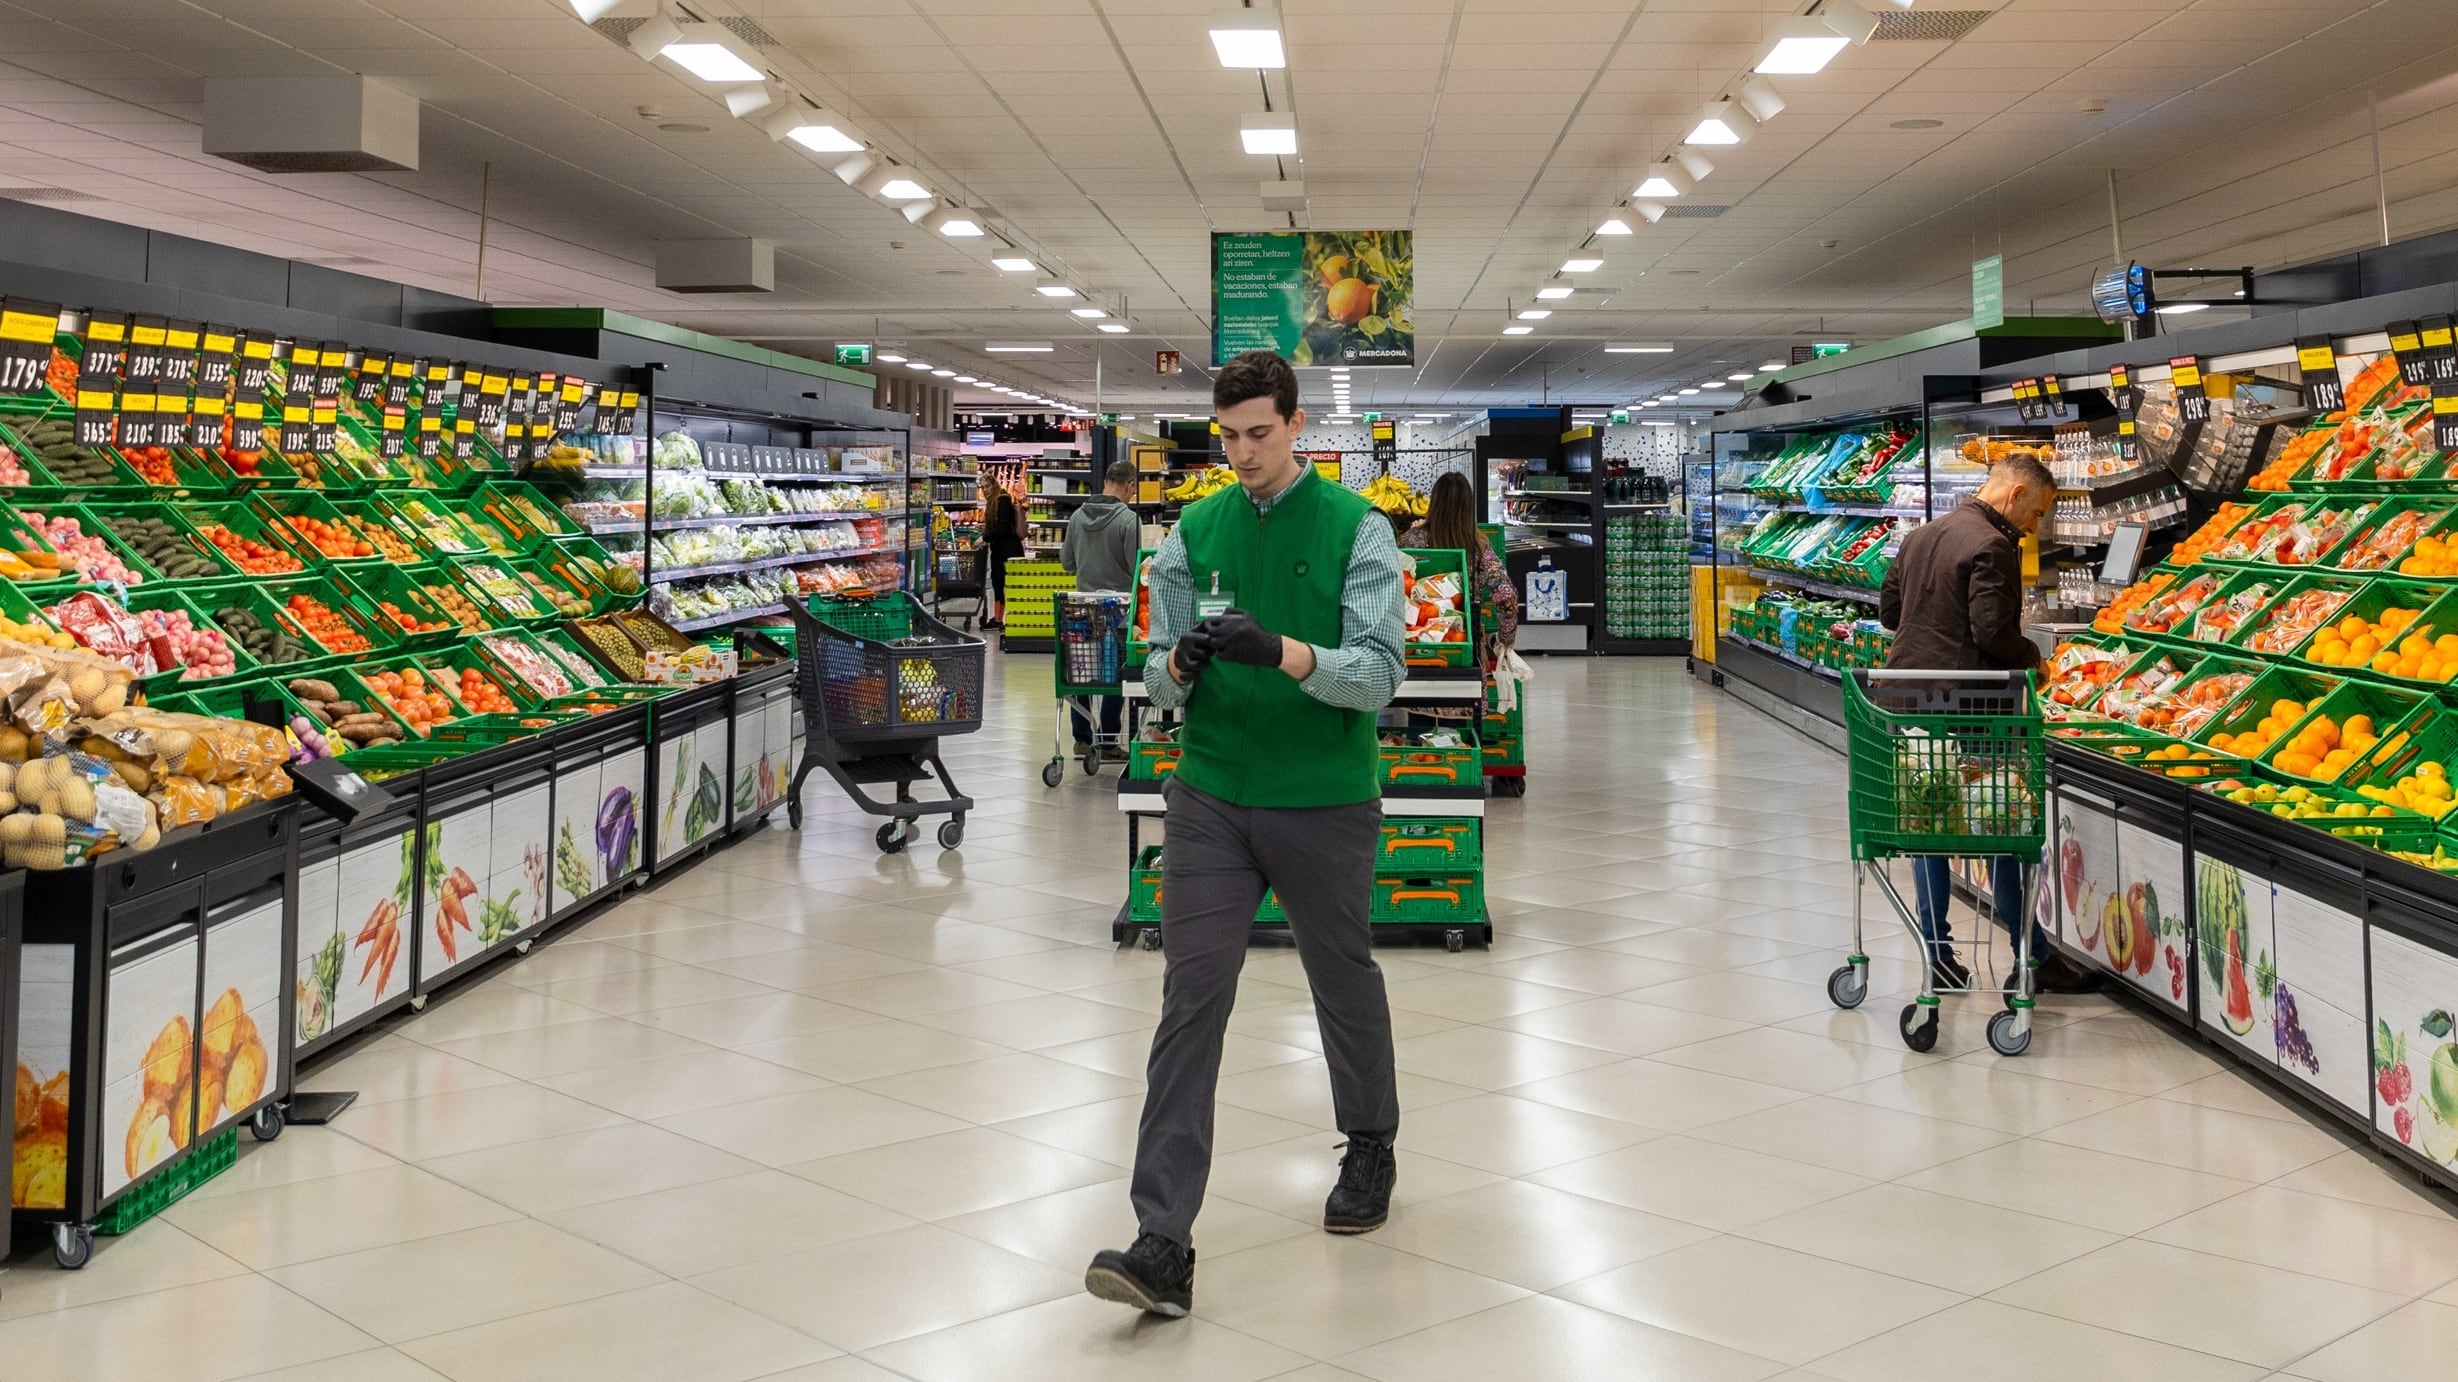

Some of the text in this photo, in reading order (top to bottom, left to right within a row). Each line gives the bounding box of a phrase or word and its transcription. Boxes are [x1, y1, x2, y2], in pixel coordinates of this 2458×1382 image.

[1223, 251, 1262, 259] oporretan,
[1236, 272, 1266, 280] estaban
[1266, 272, 1277, 280] de
[1224, 282, 1298, 290] vacaciones, estaban
[1224, 290, 1269, 298] madurando.
[1358, 350, 1407, 358] MERCADONA
